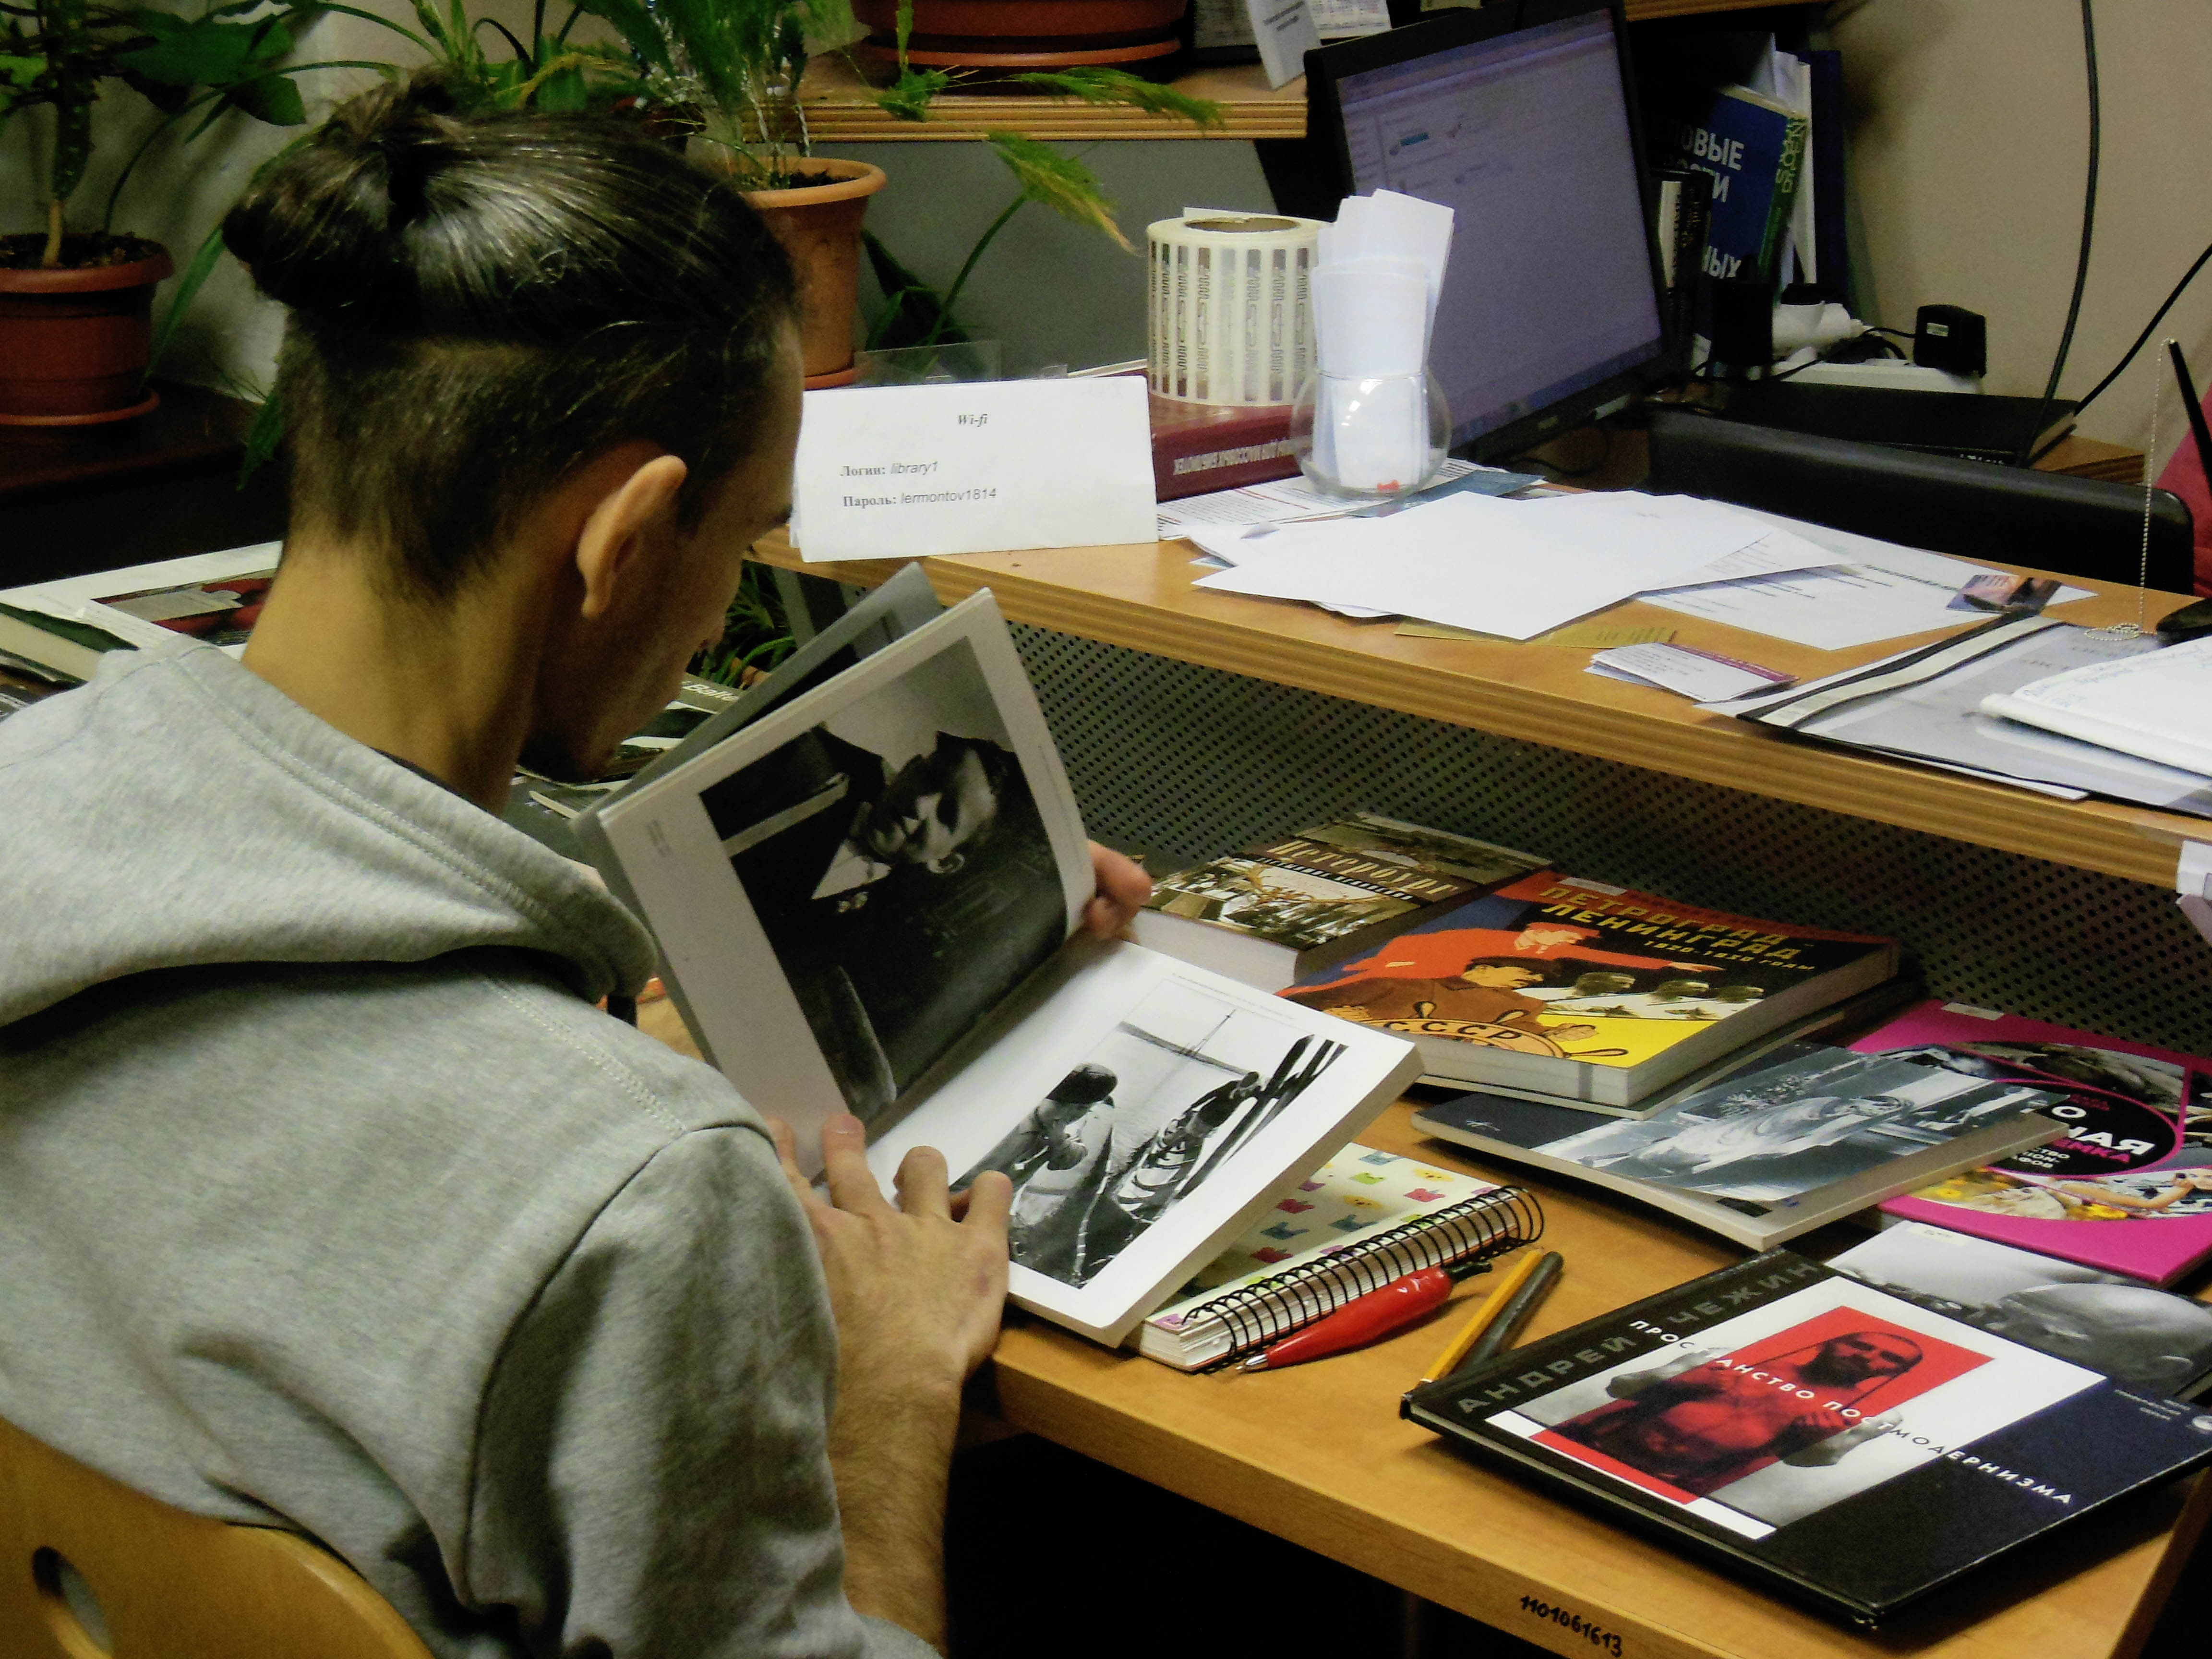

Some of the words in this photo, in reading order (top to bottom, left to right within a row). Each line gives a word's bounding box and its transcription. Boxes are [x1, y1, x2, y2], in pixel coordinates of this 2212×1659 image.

[957, 413, 988, 427] Wi-fi
[840, 465, 886, 477] Логин:
[890, 460, 938, 476] library1
[843, 494, 897, 509] Пароль:
[900, 487, 997, 504] lermontov1814
[1266, 840, 1459, 895] Петербург
[1539, 887, 1790, 945] ПЕТРОГРАД
[1541, 903, 1802, 960] ЛЕНИНГРАД
[1457, 1334, 1636, 1414] АНДРЕЙ
[1667, 1262, 1819, 1325] ЧЕЖИН
[1629, 1320, 1815, 1399] ПРОСАНСТВО
[1520, 1595, 1623, 1658] 1101061613
